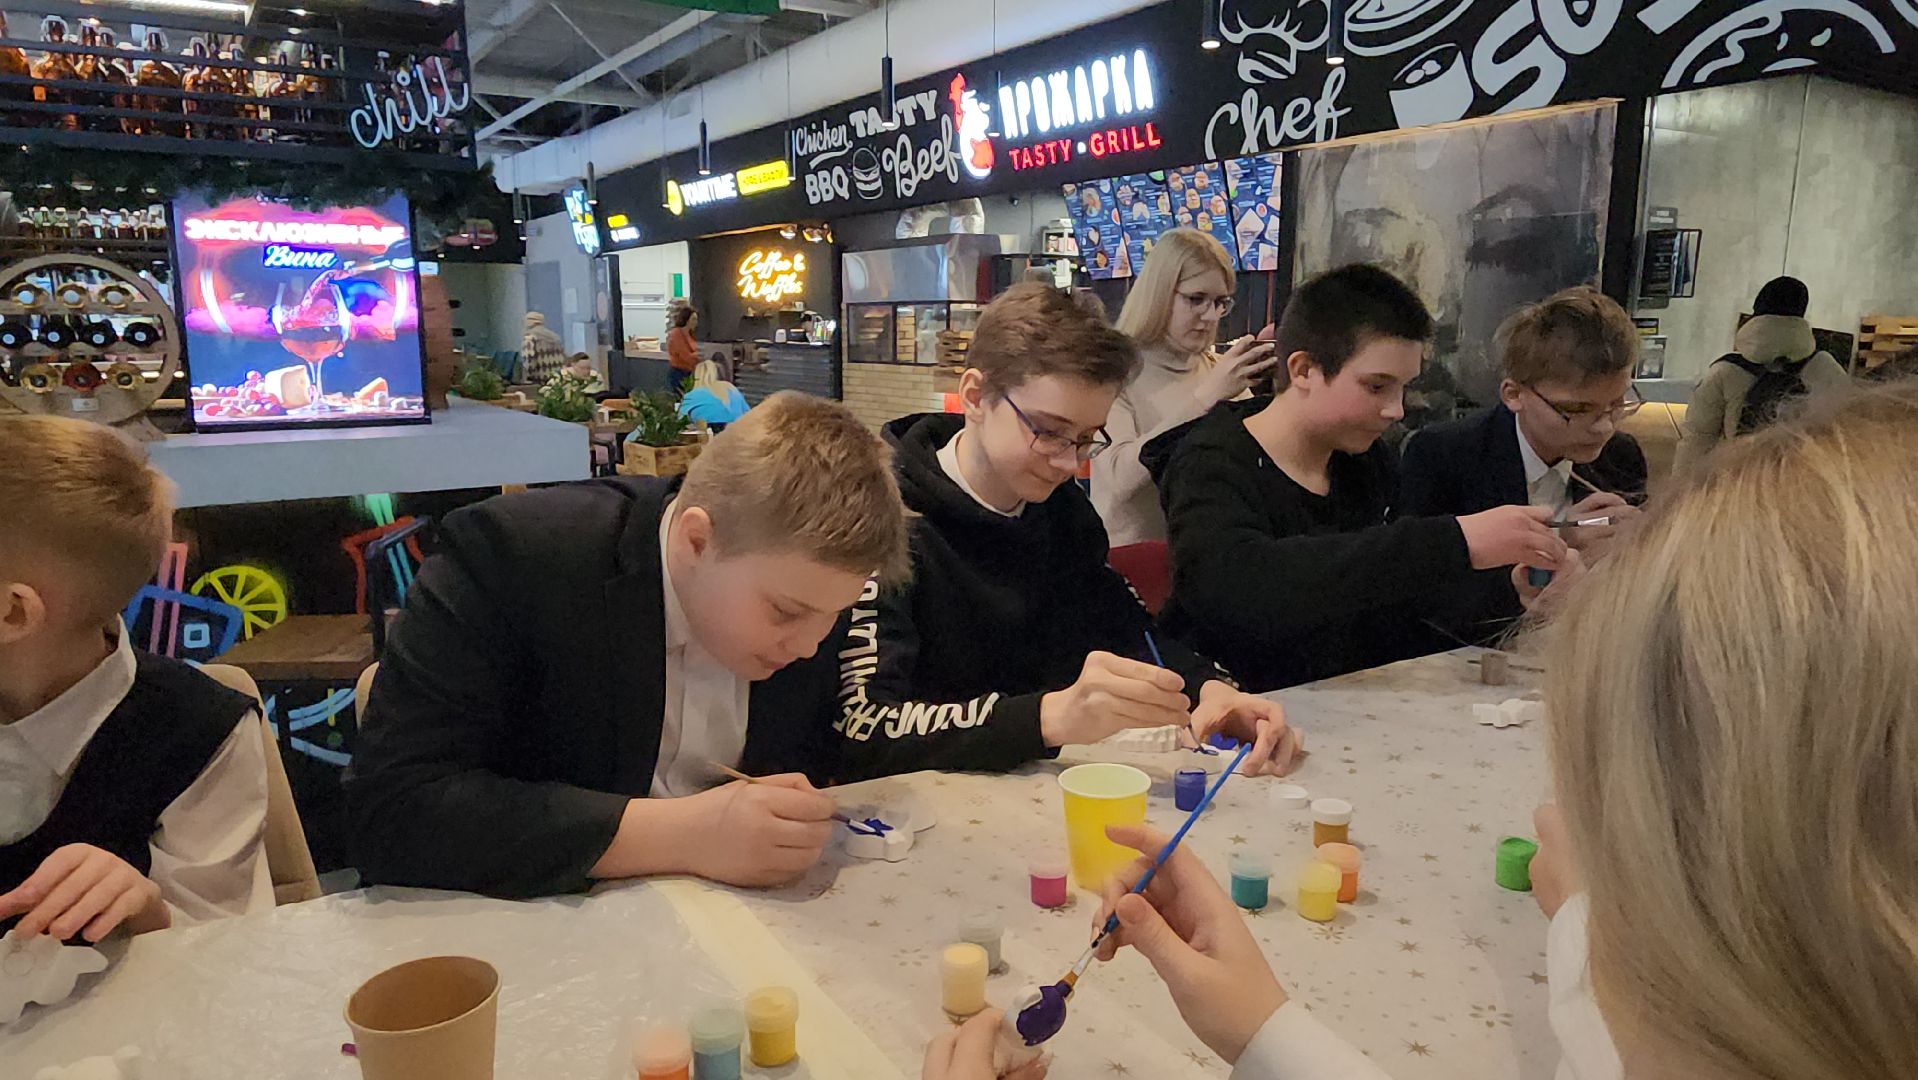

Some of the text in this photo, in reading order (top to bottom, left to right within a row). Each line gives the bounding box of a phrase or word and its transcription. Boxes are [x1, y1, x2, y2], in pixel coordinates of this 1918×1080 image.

[350, 55, 470, 148] chill
[998, 49, 1154, 140] ПРОЖАРКА
[795, 120, 853, 158] Chicken
[805, 113, 962, 204] BBQ Beef
[1008, 122, 1161, 171] TASTY GRILL
[263, 246, 338, 268] Вина
[739, 251, 806, 279] Coffee &
[737, 272, 804, 302] Waffles
